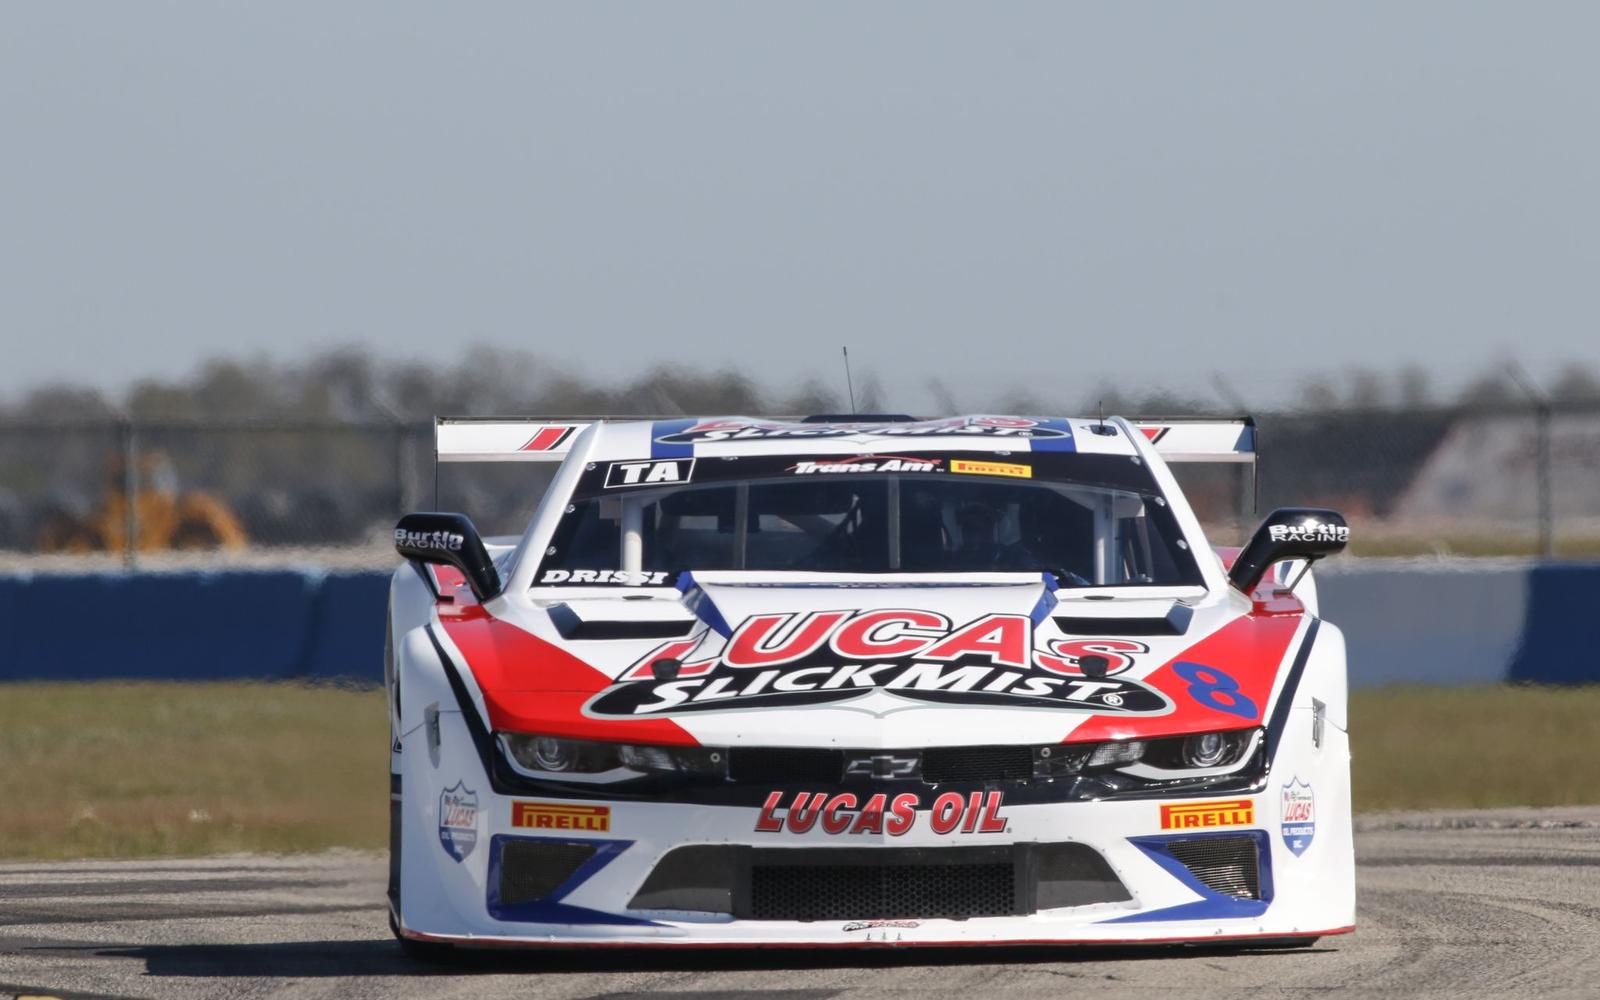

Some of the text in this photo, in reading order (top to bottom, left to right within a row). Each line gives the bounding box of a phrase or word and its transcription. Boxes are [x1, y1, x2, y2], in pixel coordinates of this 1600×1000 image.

[620, 462, 679, 483] TA
[794, 459, 934, 474] Trans Am
[615, 609, 1149, 682] LUCAS
[1171, 661, 1258, 720] 8
[512, 801, 609, 832] PIRELLI
[754, 791, 1007, 836] LUCAS OIL
[1160, 800, 1253, 829] PIRELLI
[1284, 802, 1312, 821] LUCAS
